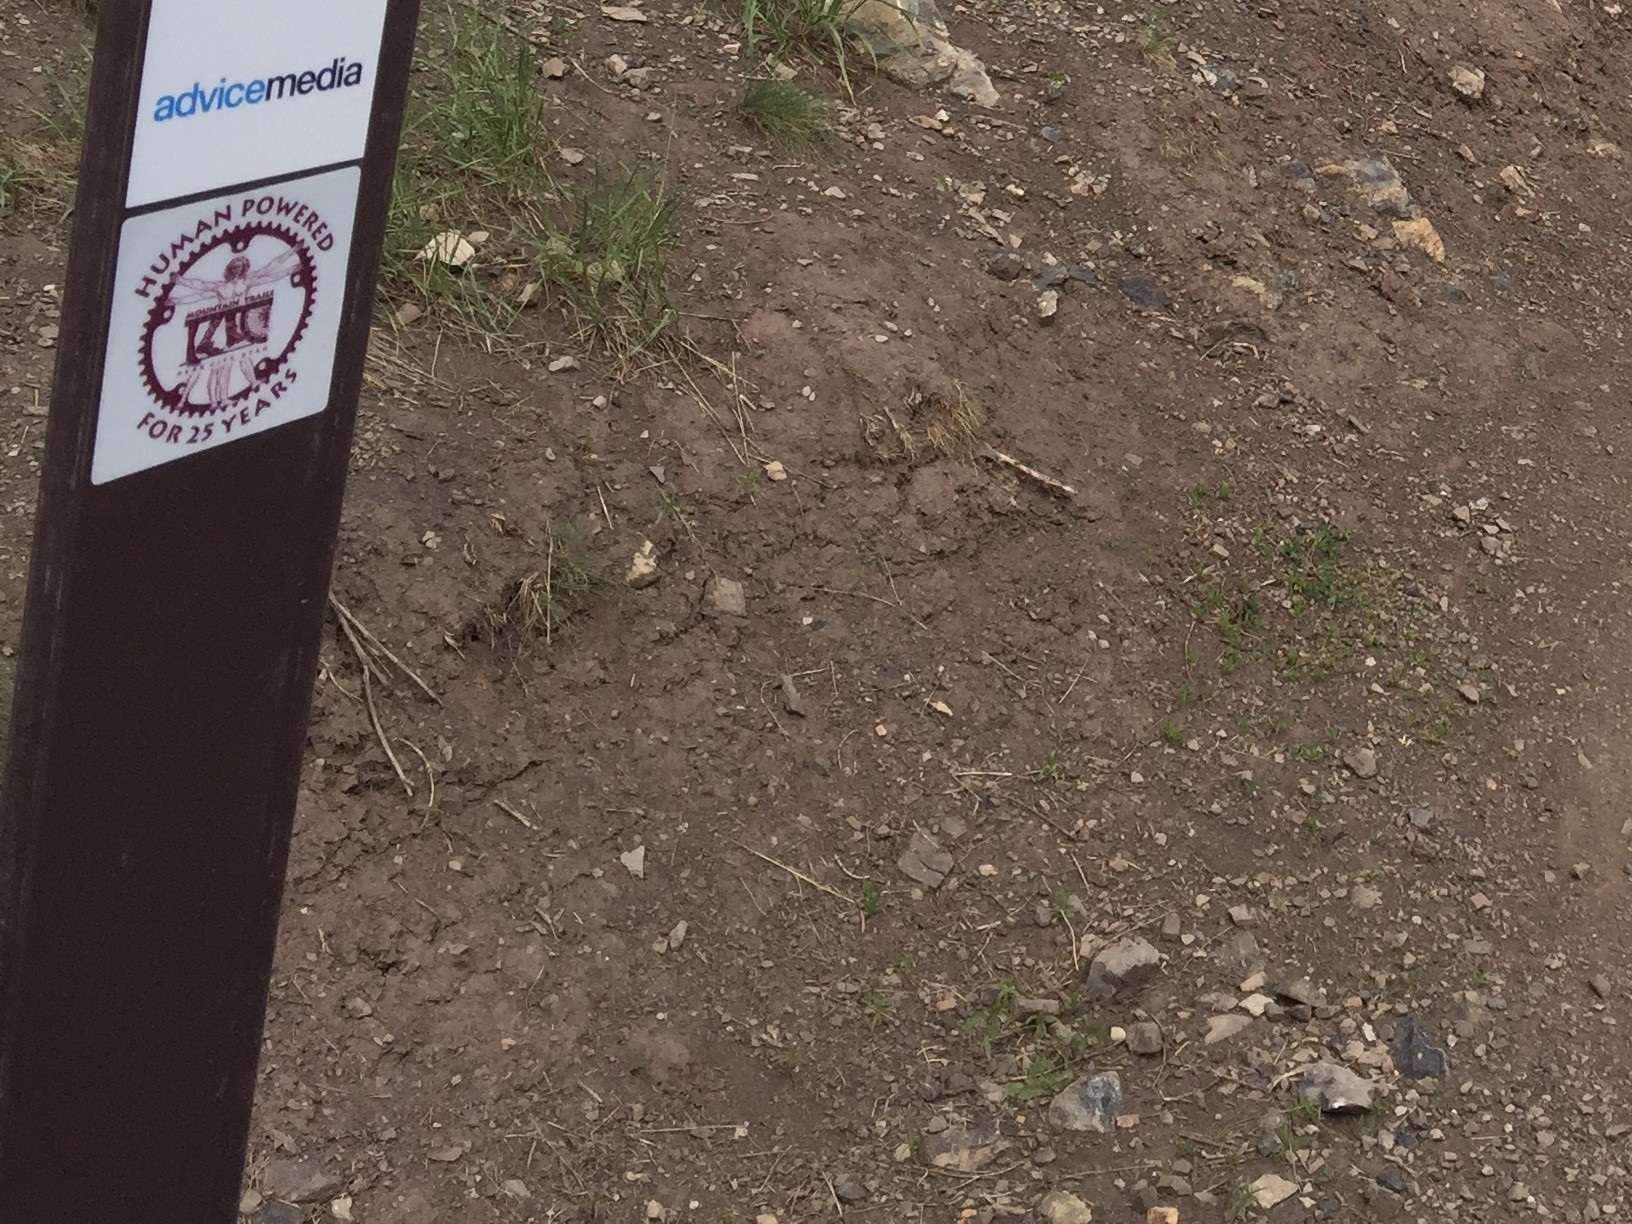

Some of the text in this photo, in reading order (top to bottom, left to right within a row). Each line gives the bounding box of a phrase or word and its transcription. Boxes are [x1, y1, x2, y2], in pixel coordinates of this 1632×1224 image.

[153, 57, 363, 122] advicemedia
[134, 196, 334, 298] HUMAN POWERED
[136, 368, 297, 444] FOR 25 YEARS
